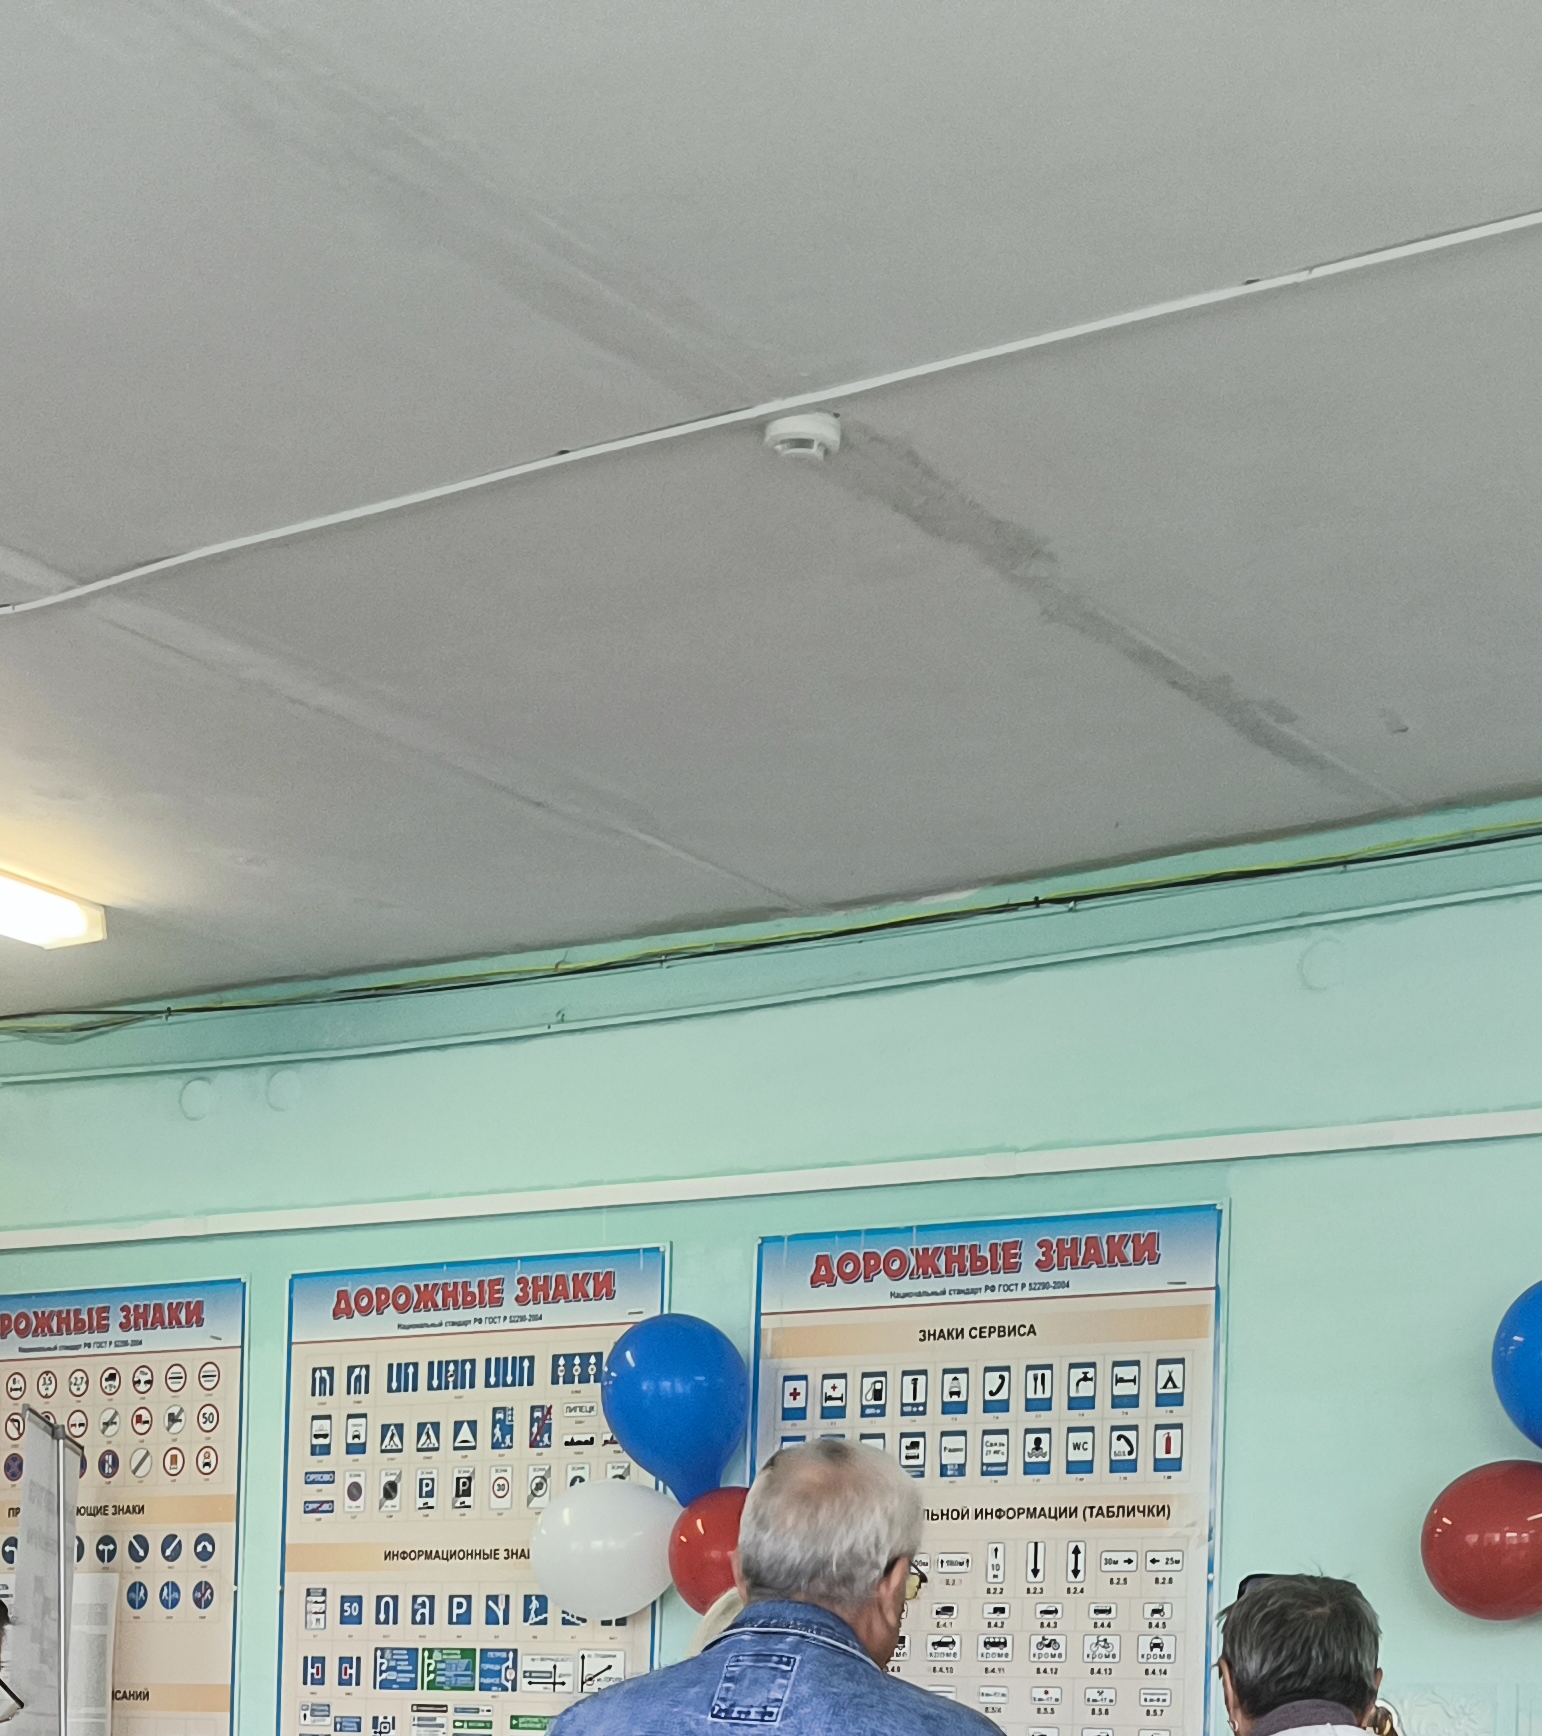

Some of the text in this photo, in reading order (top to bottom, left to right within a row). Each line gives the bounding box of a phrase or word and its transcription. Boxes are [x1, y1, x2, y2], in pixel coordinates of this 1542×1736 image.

[810, 1230, 1161, 1288] ДОРОЖНЫЕ ЗНАКИ
[984, 1284, 996, 1293] РФ
[998, 1283, 1019, 1293] ГОСТ
[1020, 1282, 1027, 1291] Р
[332, 1270, 617, 1320] ДОРОЖНЫЕ ЗНАКИ
[118, 1300, 205, 1333] ЗНАКИ
[484, 1315, 501, 1324] ГОСТ
[918, 1323, 1038, 1343] ЗНАКИ СЕРВИСА
[202, 1412, 214, 1425] 50
[1072, 1441, 1088, 1451] WC
[496, 1483, 506, 1492] 30
[111, 1504, 145, 1516] ЗНАКИ
[974, 1505, 1078, 1520] ИНФОРМАЦИИ
[1082, 1504, 1171, 1522] (ТАБЛИЧКИ)
[384, 1548, 530, 1562] ИНФОРМАЦИОННЫЕ ЗНА
[1067, 1587, 1084, 1595] 8.2.4
[343, 1602, 359, 1616] 50
[452, 1597, 467, 1623] P
